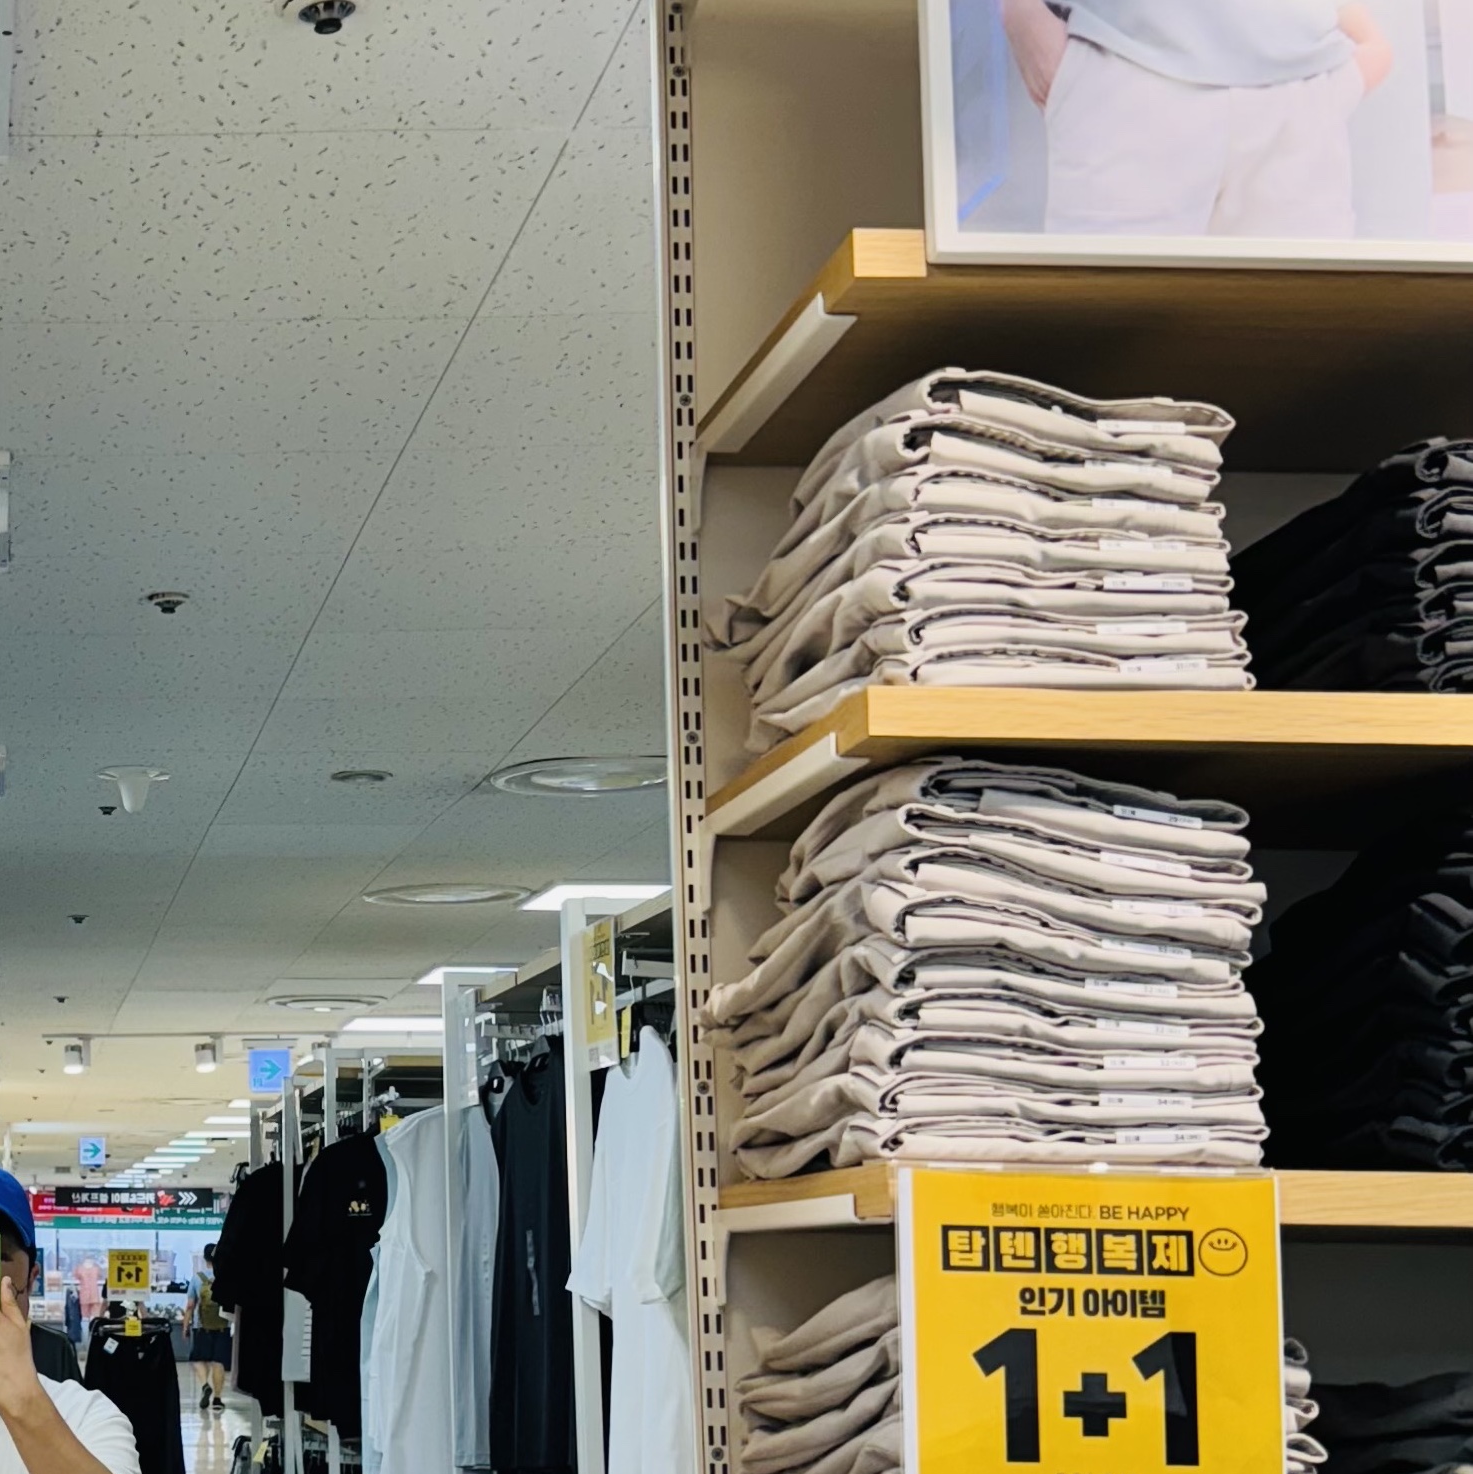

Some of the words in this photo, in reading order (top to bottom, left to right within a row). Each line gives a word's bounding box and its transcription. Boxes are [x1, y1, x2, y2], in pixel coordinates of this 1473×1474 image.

[991, 1202, 1034, 1218] 행복이
[1099, 1205, 1124, 1221] BE
[1127, 1206, 1190, 1222] HAPPY
[944, 1227, 1193, 1274] 탑텐행복제
[1019, 1286, 1075, 1317] 인기
[1082, 1288, 1166, 1319] 아이템
[972, 1327, 1200, 1466] 1+1
